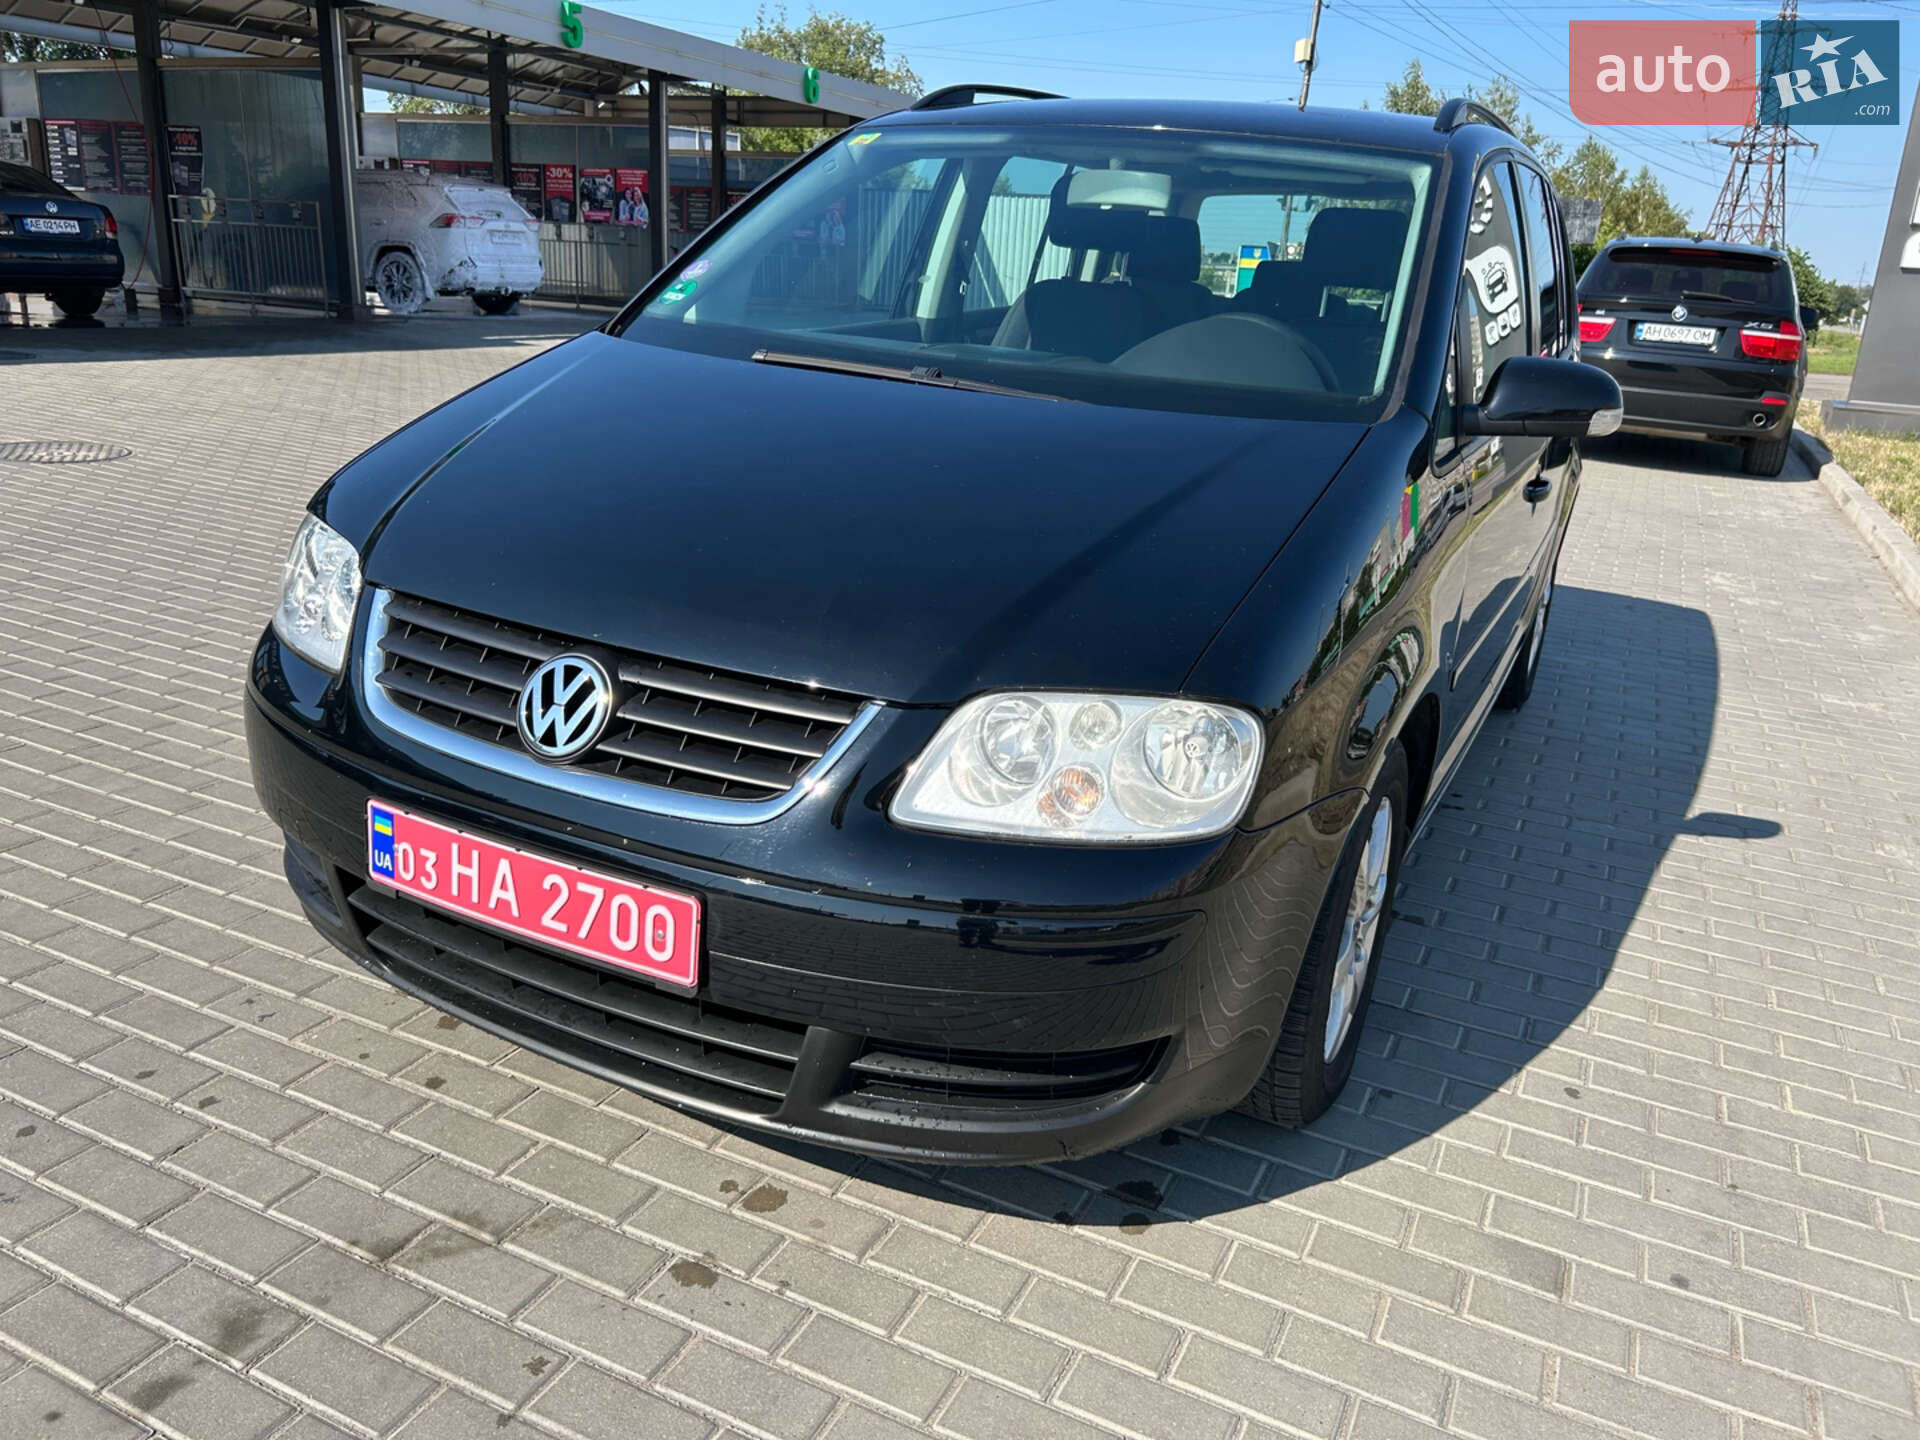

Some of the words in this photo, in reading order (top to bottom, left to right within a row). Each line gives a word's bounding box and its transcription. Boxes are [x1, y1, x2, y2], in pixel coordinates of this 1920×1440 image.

[561, 1, 583, 48] 5
[804, 67, 820, 104] 6
[546, 167, 573, 178] -30%
[1664, 327, 1691, 339] 0697
[374, 849, 392, 871] UA
[398, 842, 438, 890] 03
[451, 842, 520, 918] HA
[541, 873, 675, 962] 2700
